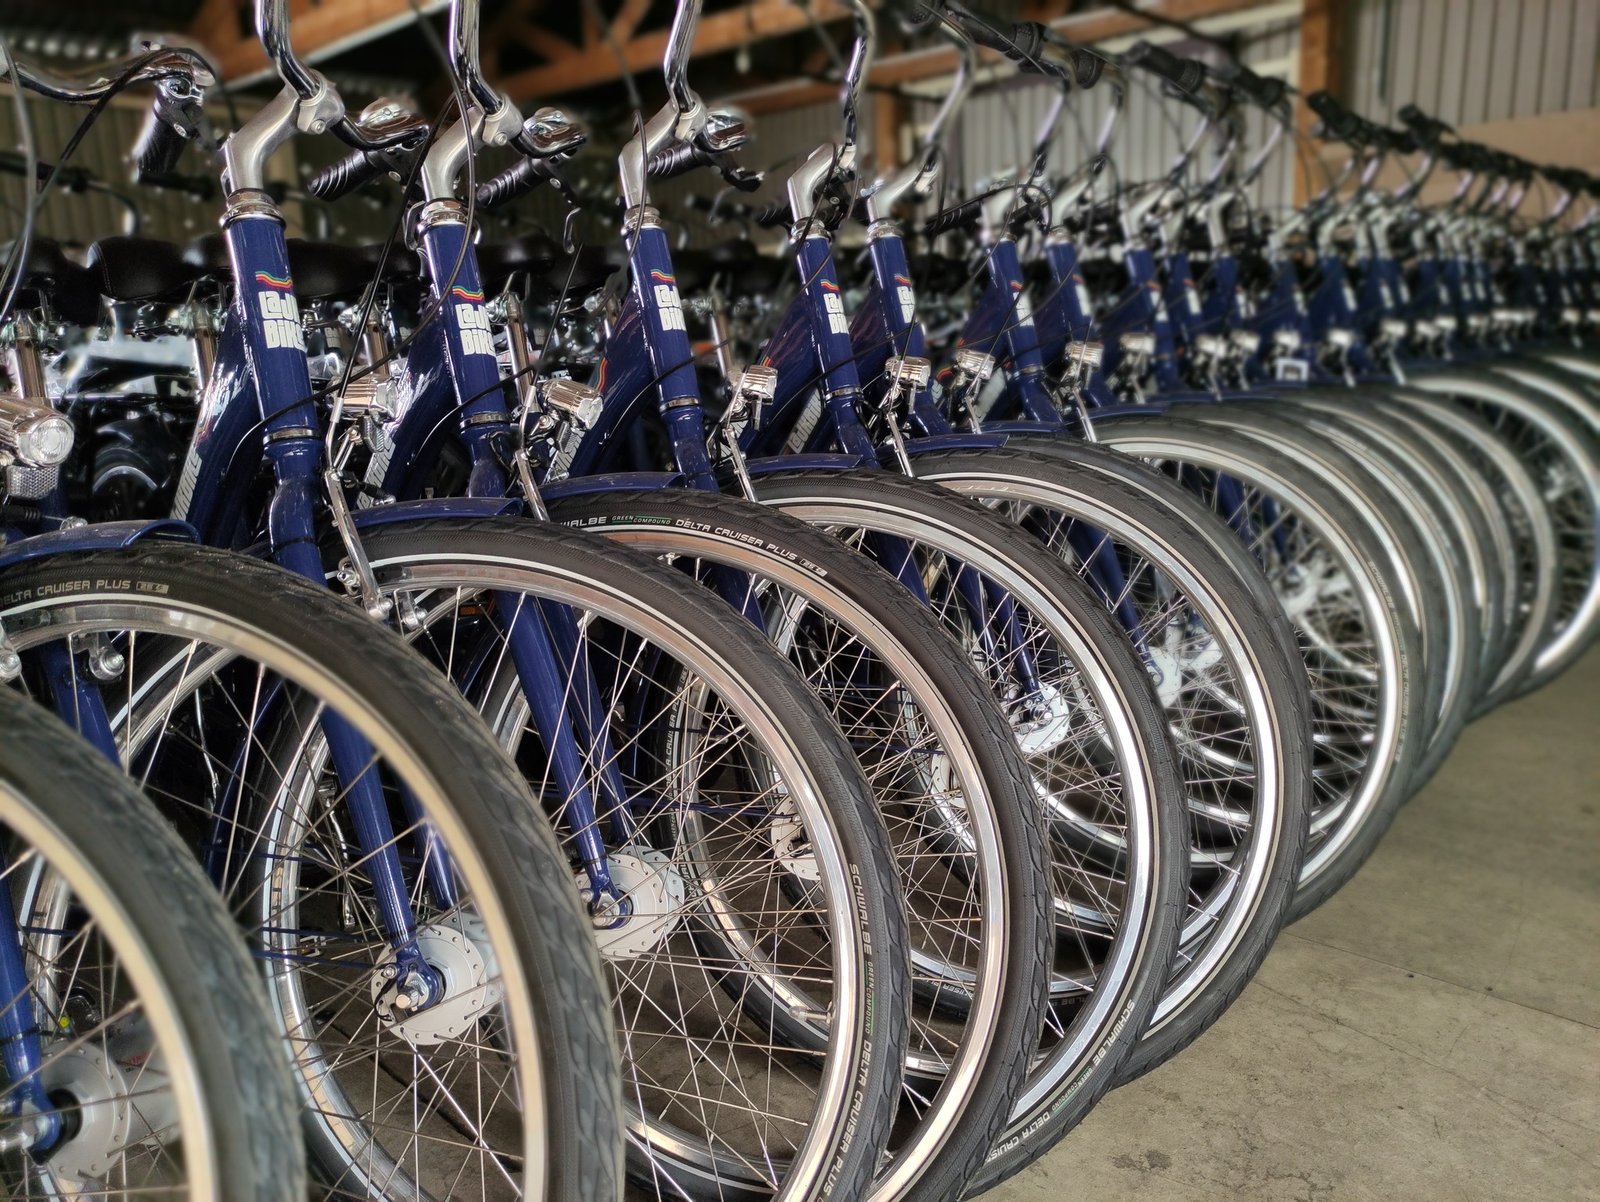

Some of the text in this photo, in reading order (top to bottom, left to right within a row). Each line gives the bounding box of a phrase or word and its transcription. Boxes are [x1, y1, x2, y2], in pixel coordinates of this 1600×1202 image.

[633, 517, 671, 525] COMPOUND
[675, 519, 711, 532] DELTA
[714, 526, 763, 547] CRUISER
[766, 543, 798, 561] PLUS
[37, 580, 91, 597] CRUISER
[96, 580, 131, 591] PLUS
[823, 863, 875, 1197] SCHWALBE GREEN COMPOUND DELTA CRUISER PLUS
[1092, 999, 1136, 1067] SCHWALBE
[1022, 1111, 1051, 1140] DELTA
